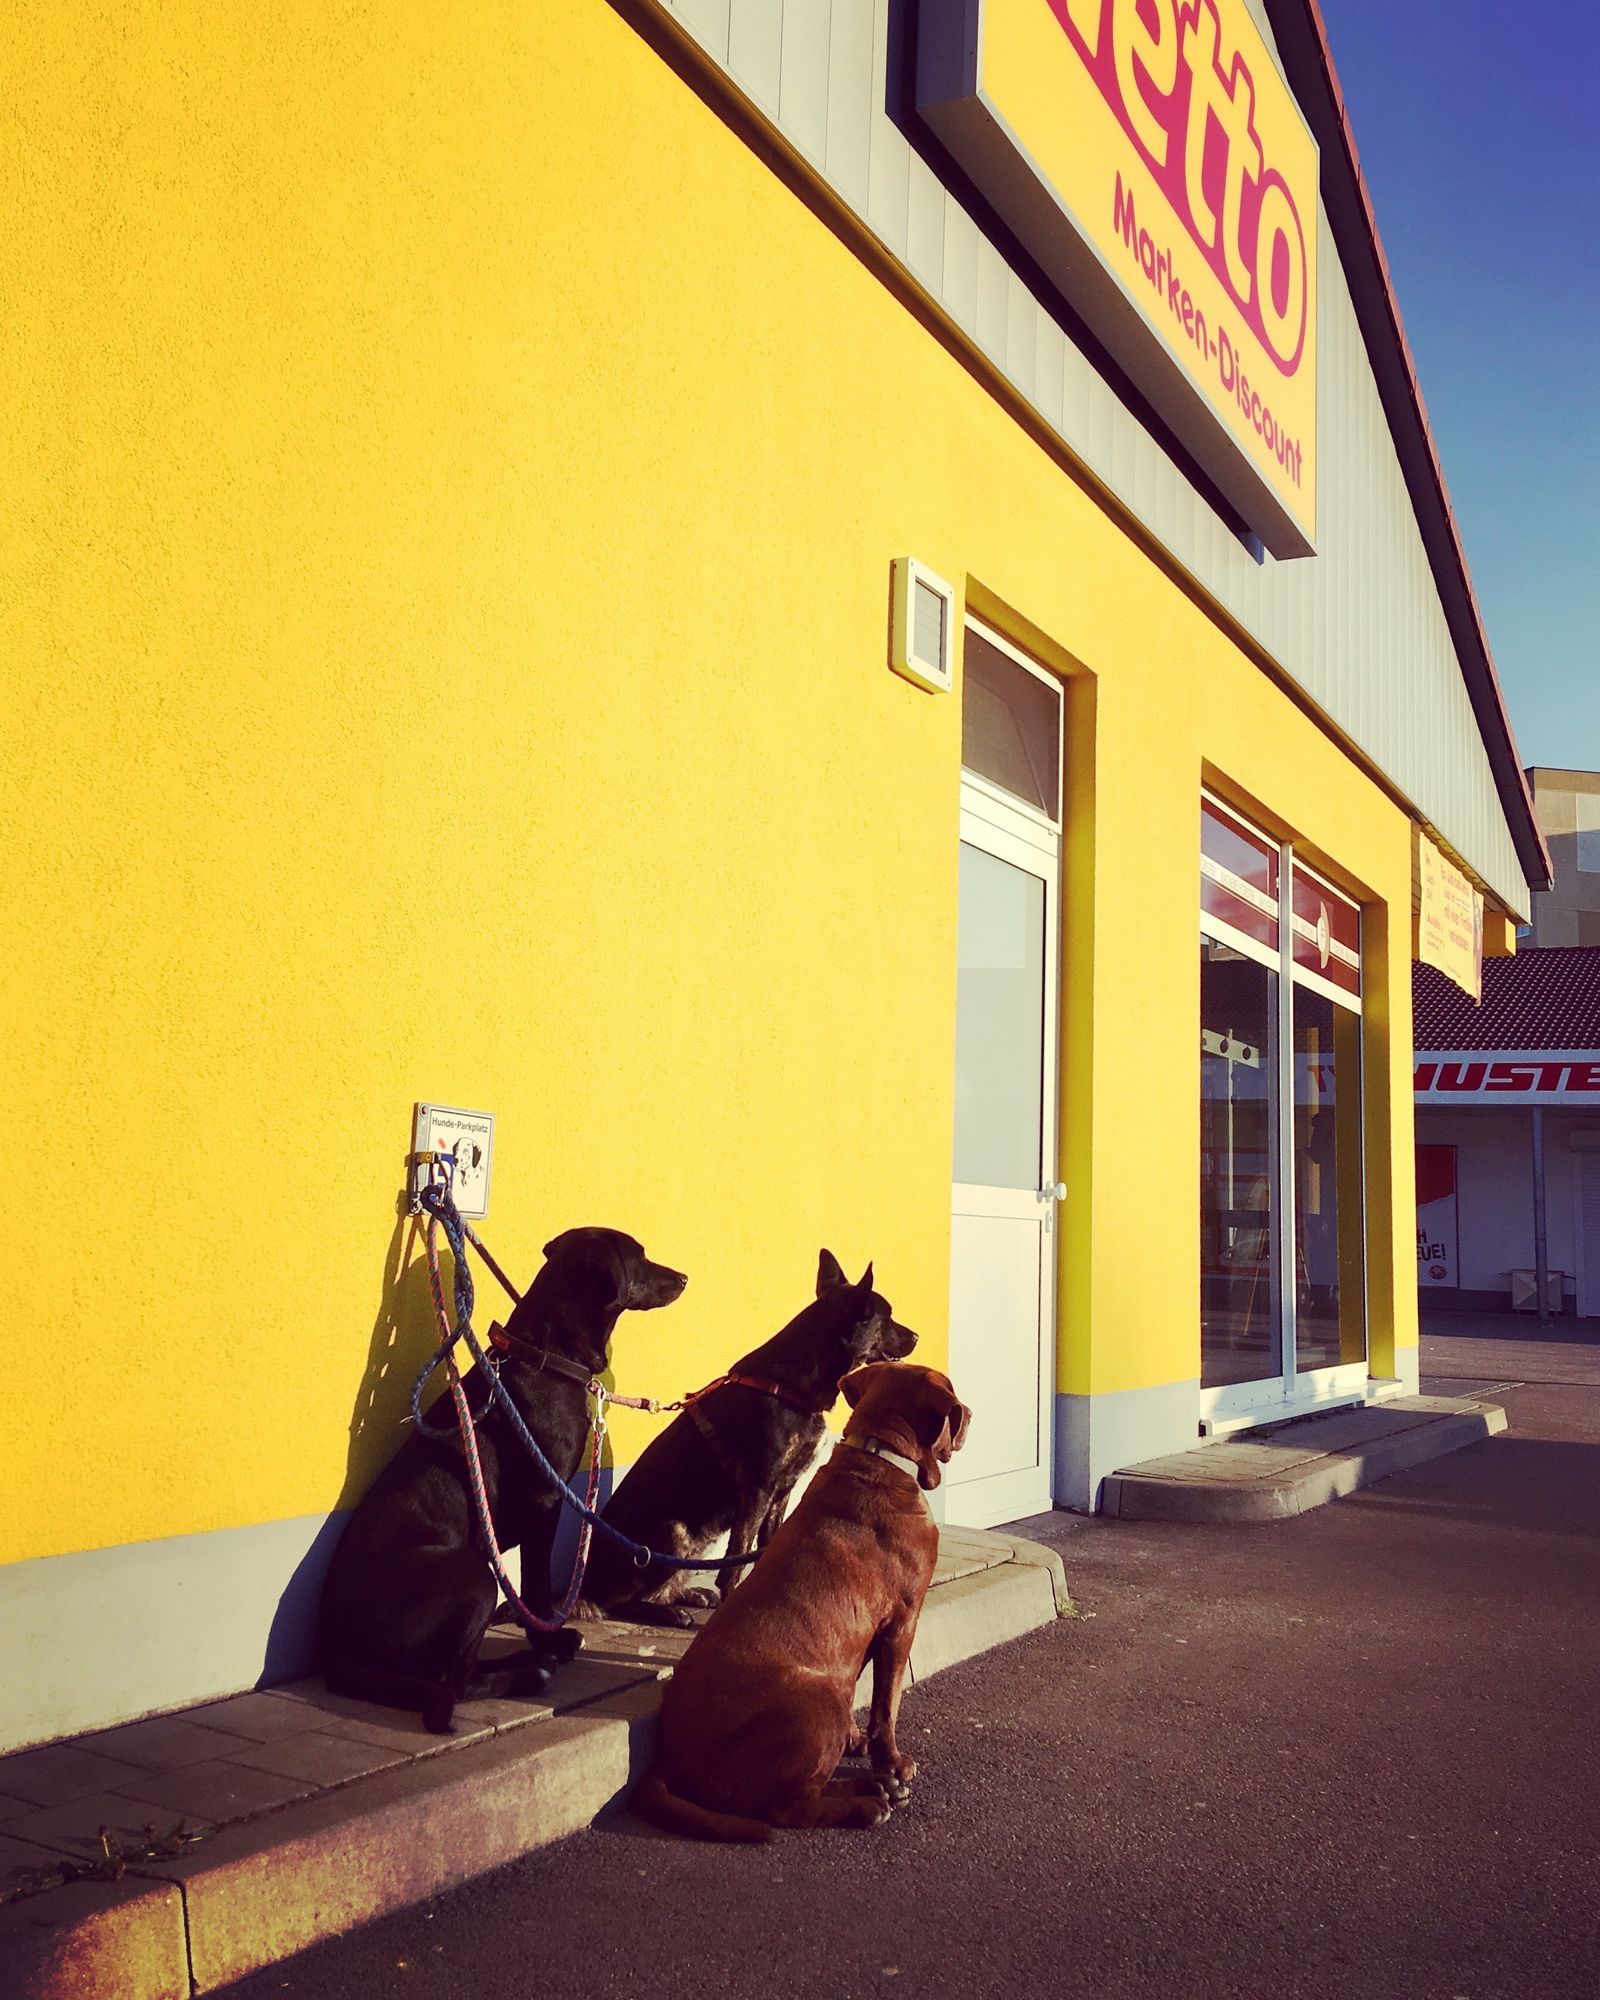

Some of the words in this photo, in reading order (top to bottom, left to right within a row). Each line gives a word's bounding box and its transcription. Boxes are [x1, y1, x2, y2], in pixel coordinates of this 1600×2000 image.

[1047, 0, 1307, 376] etto
[1113, 170, 1302, 488] Marken-Discount
[432, 1117, 489, 1133] Hunde-Parkplatz
